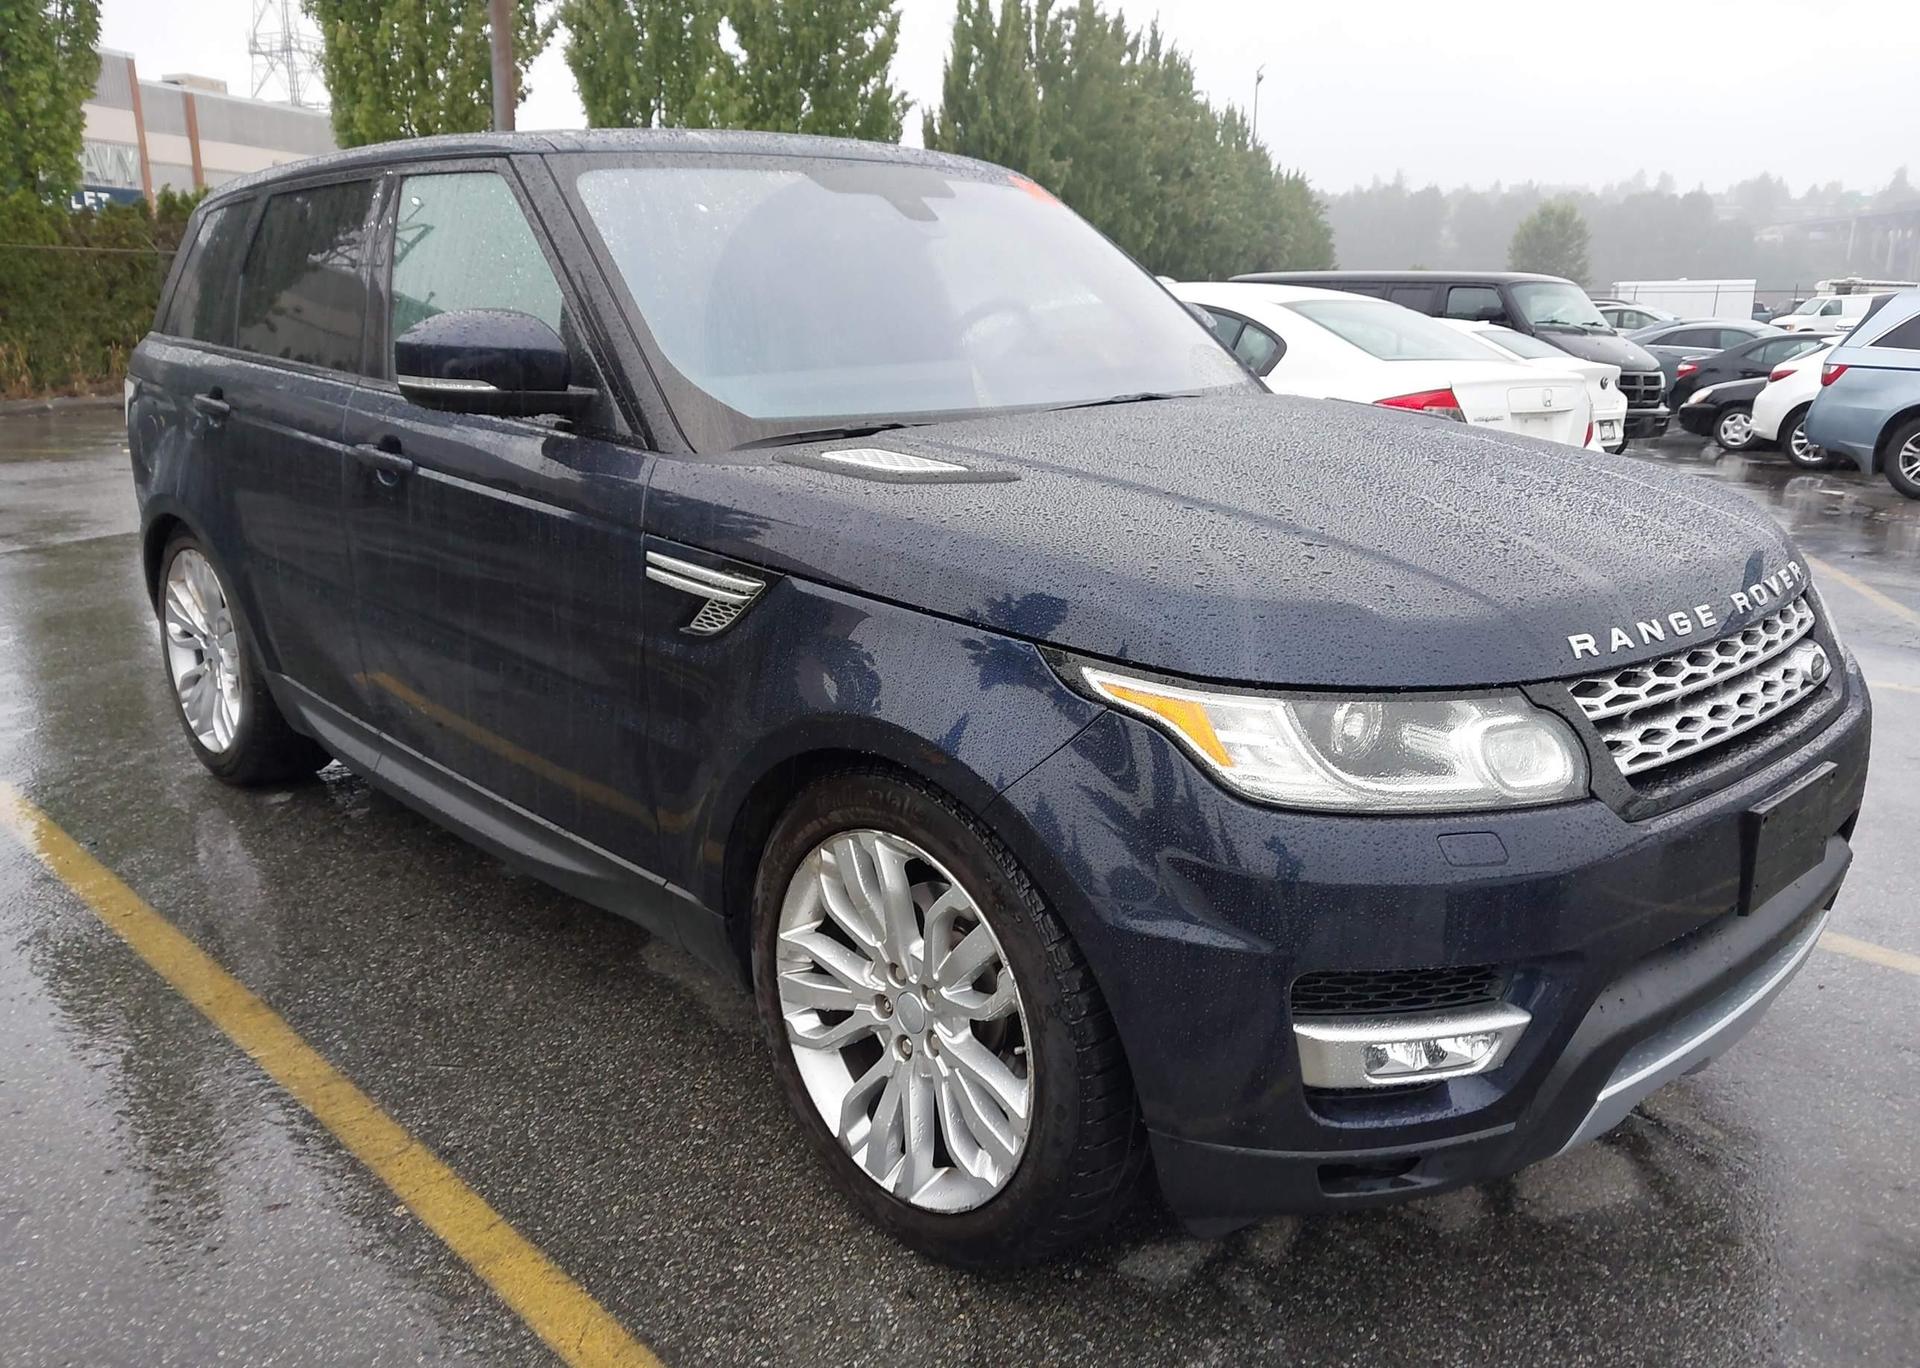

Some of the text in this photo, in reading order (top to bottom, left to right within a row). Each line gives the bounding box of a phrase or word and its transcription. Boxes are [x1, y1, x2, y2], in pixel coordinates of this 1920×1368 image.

[81, 145, 138, 183] AVY
[70, 190, 110, 212] LET
[1567, 560, 1804, 660] RANGE ROVER
